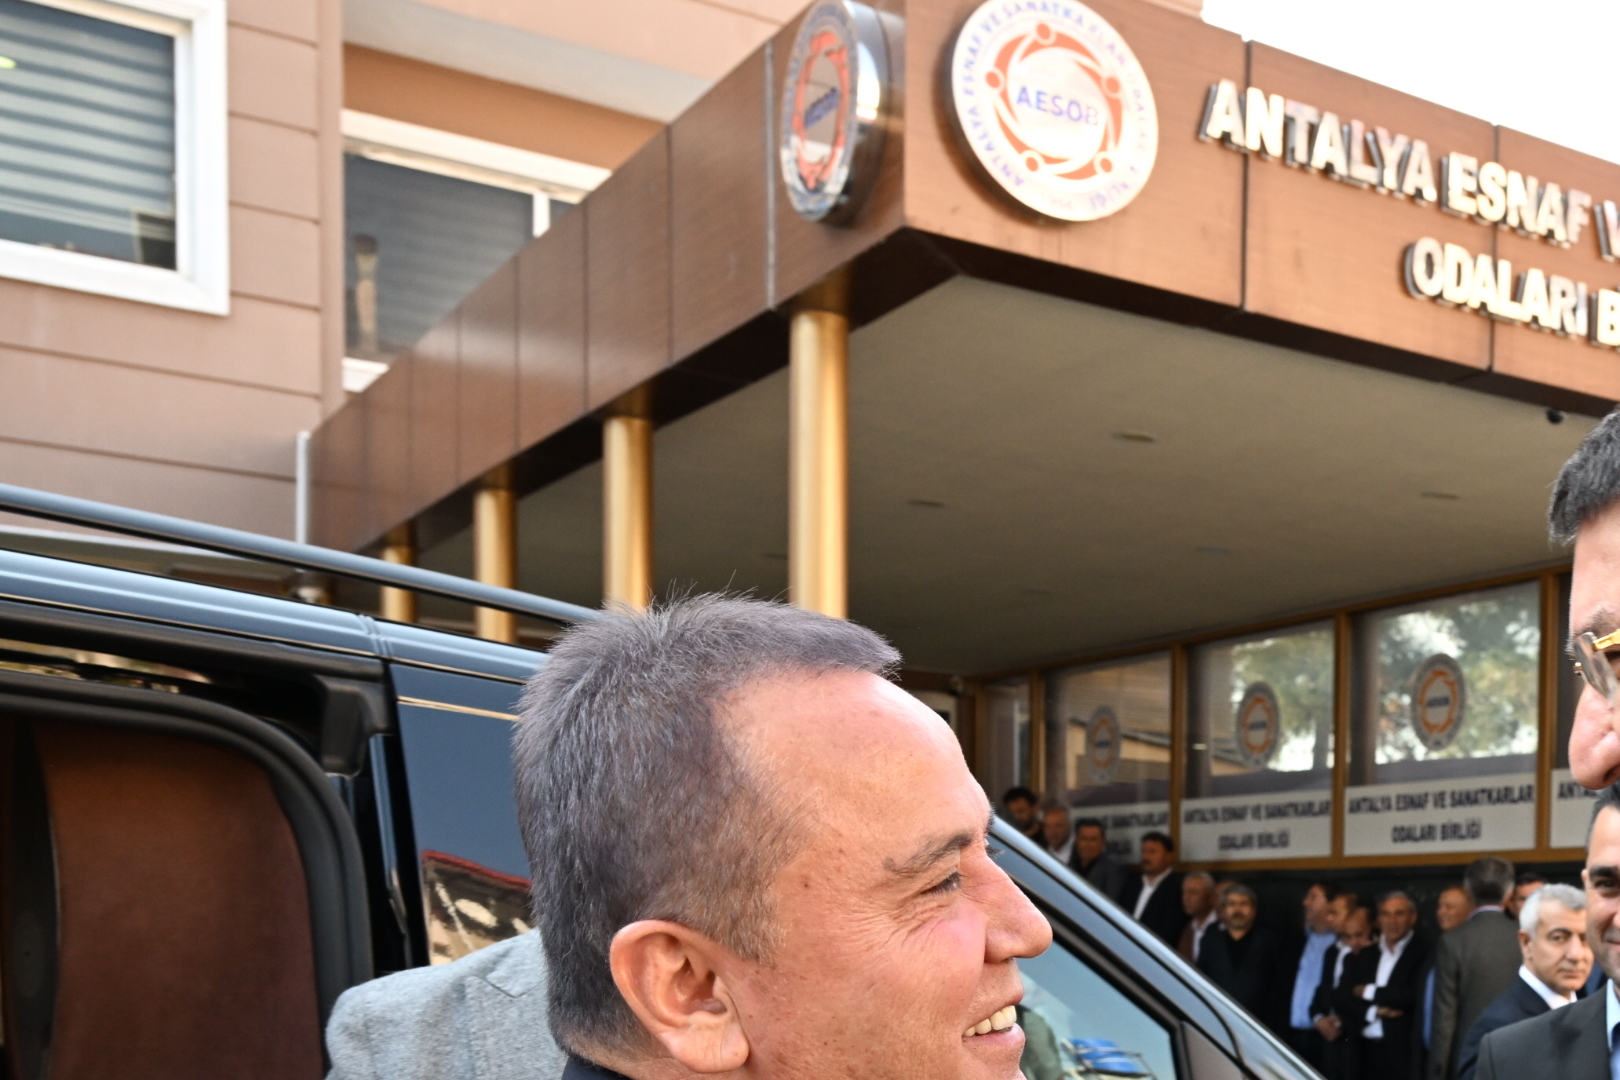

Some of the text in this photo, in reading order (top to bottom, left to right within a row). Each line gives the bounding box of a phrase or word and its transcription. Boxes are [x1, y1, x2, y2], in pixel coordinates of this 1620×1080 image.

[1016, 86, 1099, 126] AESOB
[1200, 78, 1438, 204] ANTALYA
[1443, 151, 1592, 247] ESNAF
[1405, 237, 1588, 338] ODALARI
[1348, 784, 1535, 815] ANTALYA ESNAF VE SANATKARLAR
[1391, 823, 1437, 844] ODALARI
